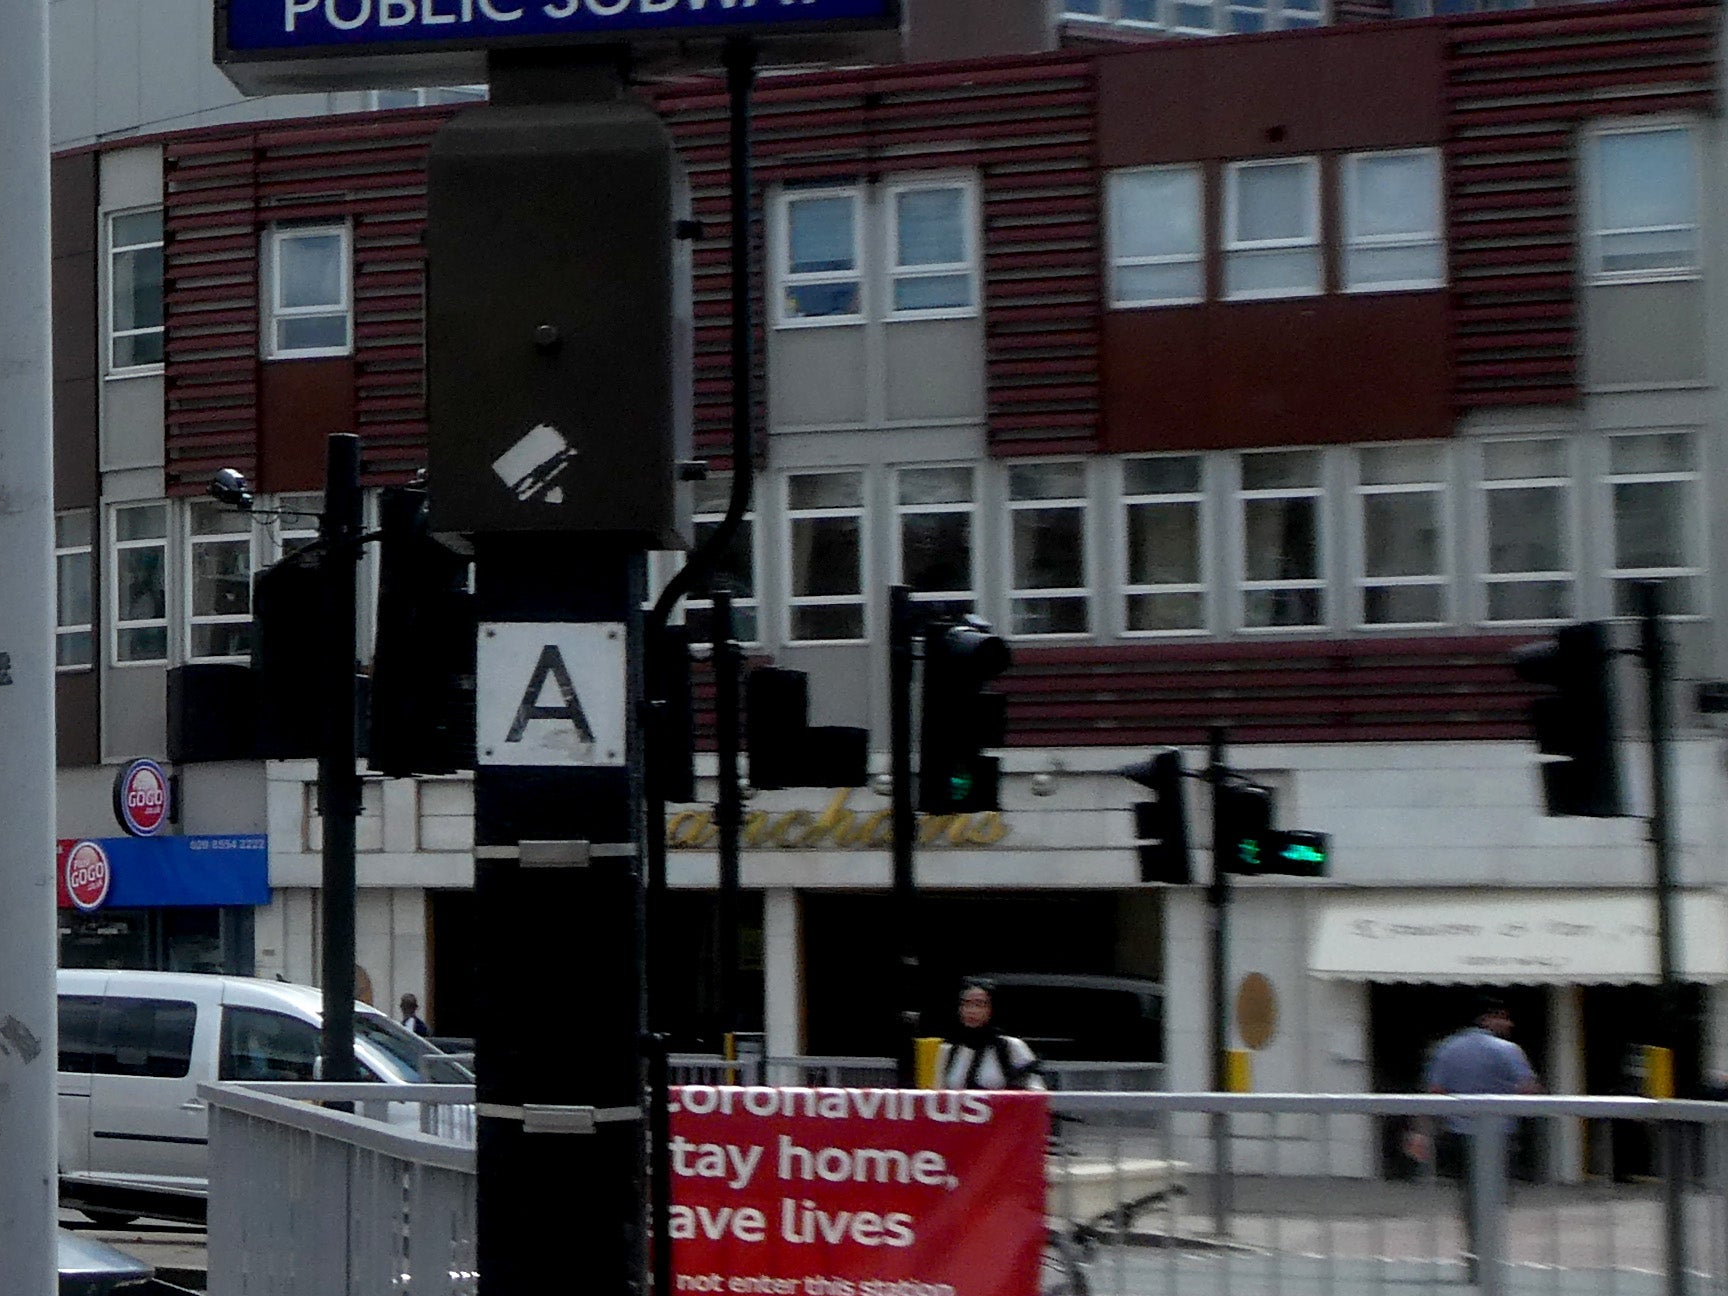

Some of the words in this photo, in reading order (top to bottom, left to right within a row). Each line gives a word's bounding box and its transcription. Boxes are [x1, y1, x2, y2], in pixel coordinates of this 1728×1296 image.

[506, 644, 594, 743] A
[128, 790, 163, 807] GOGO
[666, 787, 1005, 846] anchans
[71, 861, 105, 888] GOGO
[668, 1086, 992, 1124] oronavirus
[671, 1138, 762, 1186] tay
[777, 1135, 959, 1190] home,
[668, 1207, 765, 1243] ave
[780, 1199, 915, 1247] lives
[676, 1273, 724, 1292] not
[728, 1275, 801, 1295] enter
[803, 1275, 856, 1296] this
